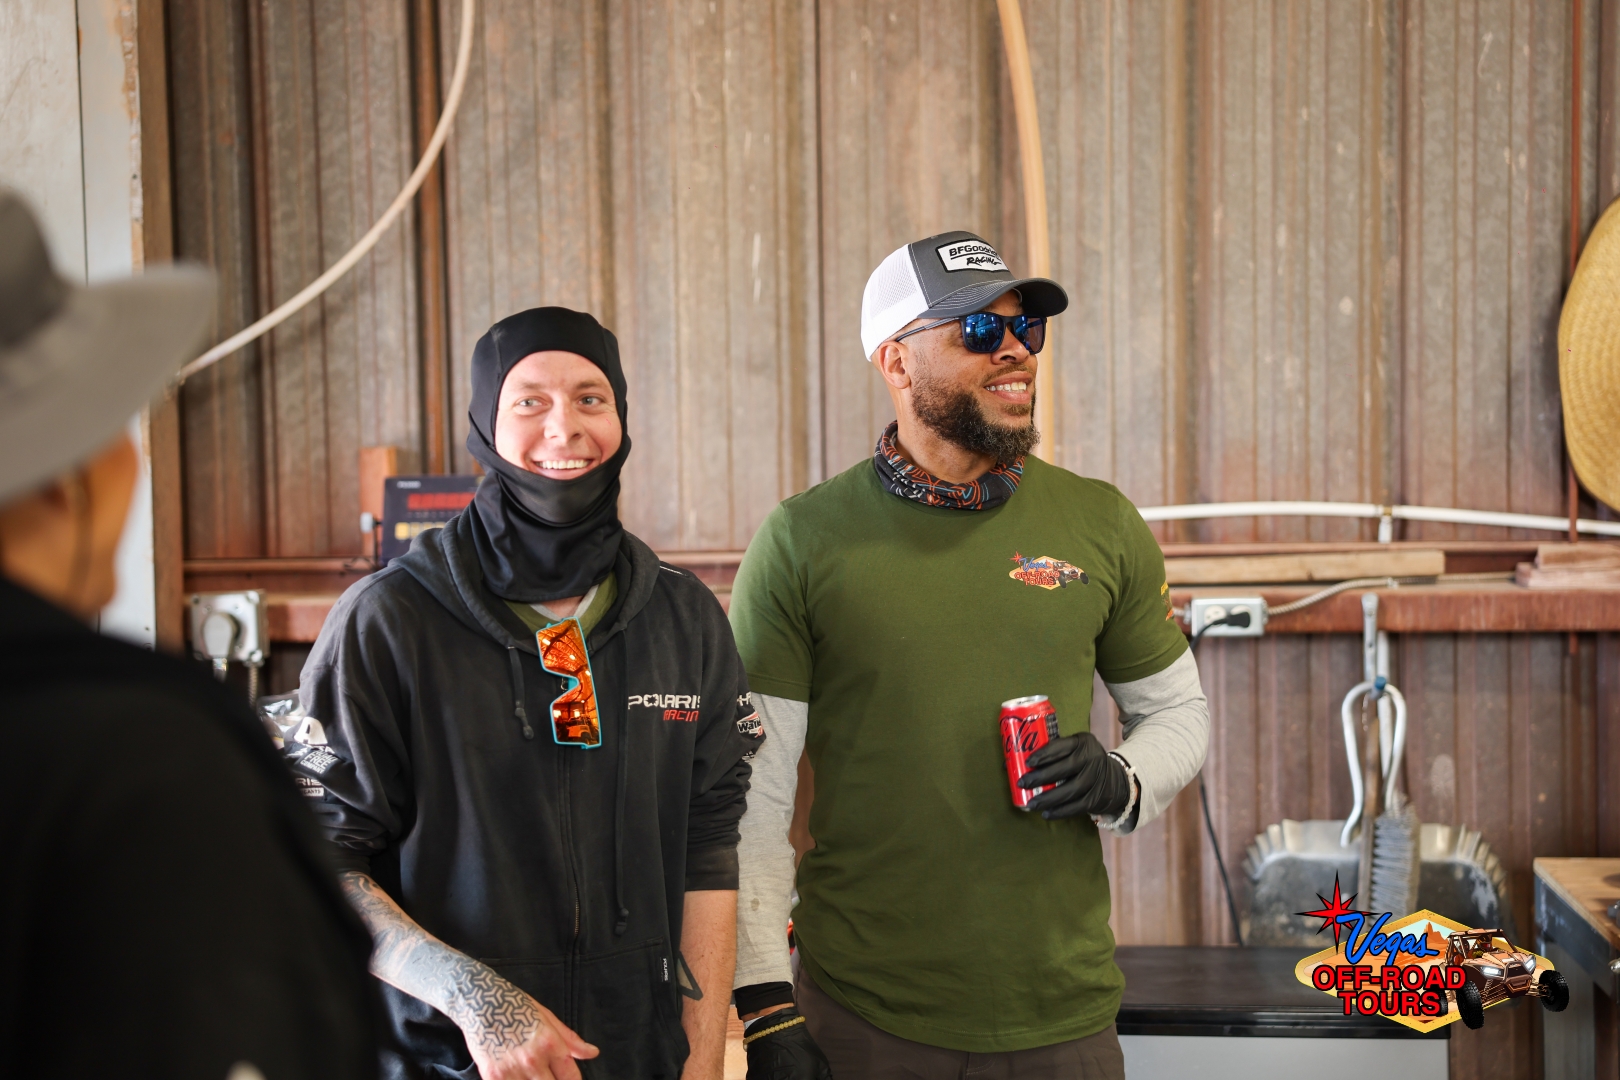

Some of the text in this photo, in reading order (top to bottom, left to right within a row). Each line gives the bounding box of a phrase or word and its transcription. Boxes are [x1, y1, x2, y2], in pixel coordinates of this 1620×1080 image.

[1019, 557, 1050, 572] Vegas
[1014, 571, 1060, 580] OFF-ROAD
[1024, 577, 1055, 586] TOURS
[663, 709, 699, 722] RACIN
[304, 752, 331, 769] FREE
